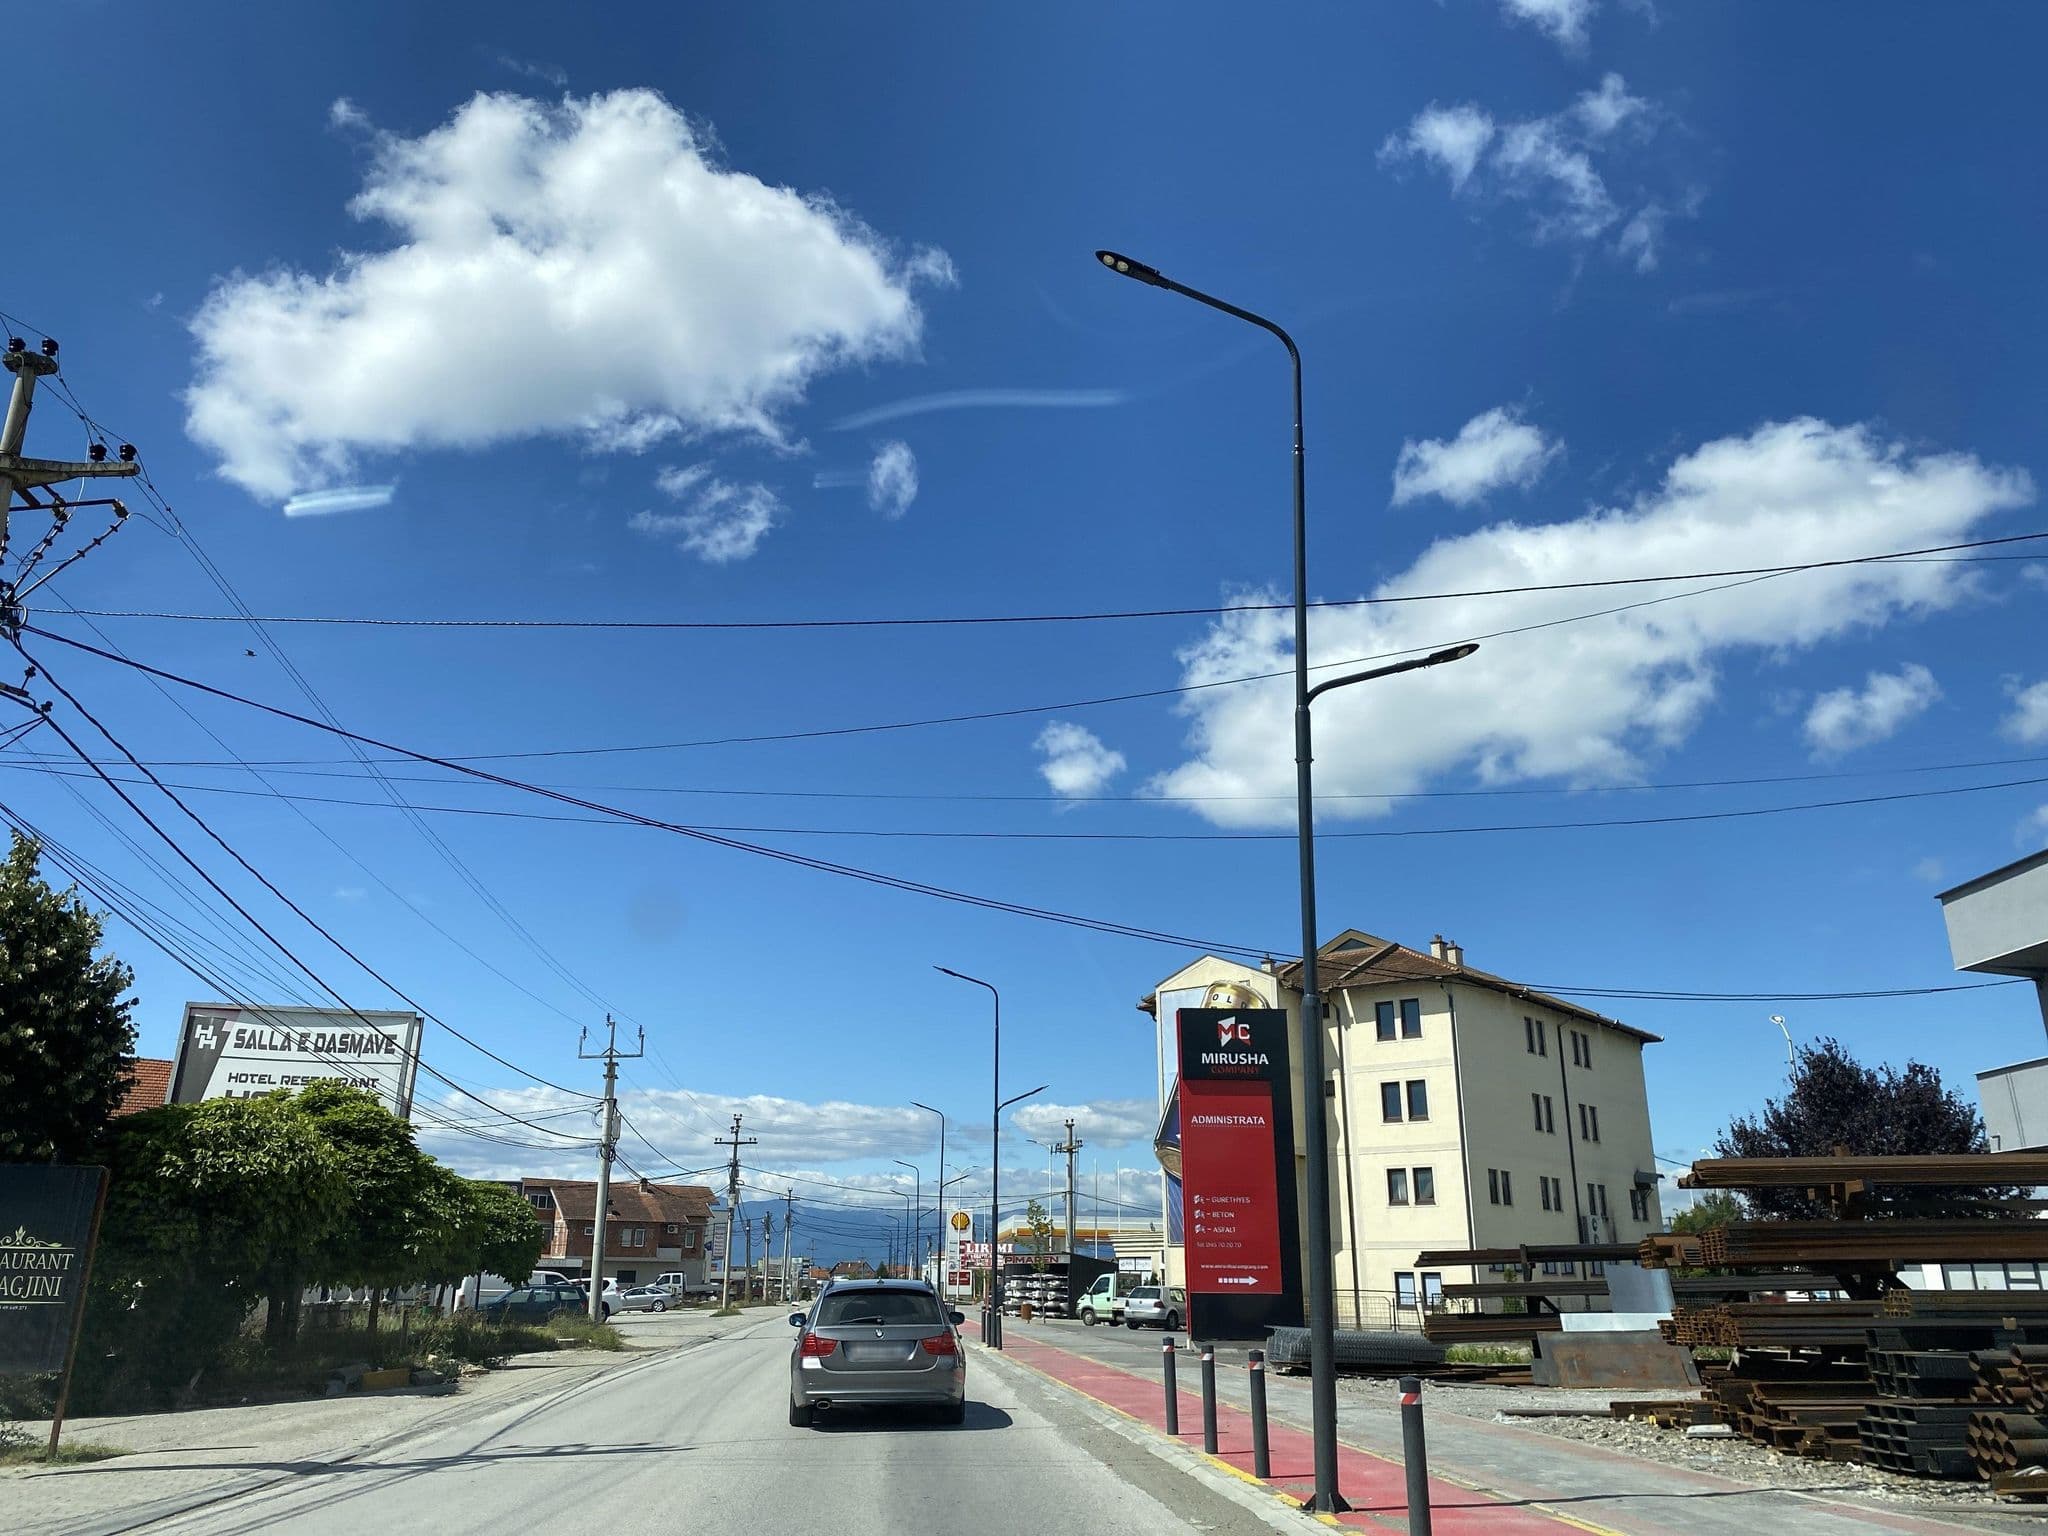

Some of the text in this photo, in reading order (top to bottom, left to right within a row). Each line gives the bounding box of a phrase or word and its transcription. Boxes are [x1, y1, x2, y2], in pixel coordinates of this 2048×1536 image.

[233, 1028, 398, 1058] SALLA E DASMAVE
[1201, 1053, 1269, 1065] MIRUSHA
[227, 1072, 277, 1085] HOTEL
[1191, 1115, 1265, 1125] ADMINISTRATA
[1213, 1226, 1236, 1234] ASFALT
